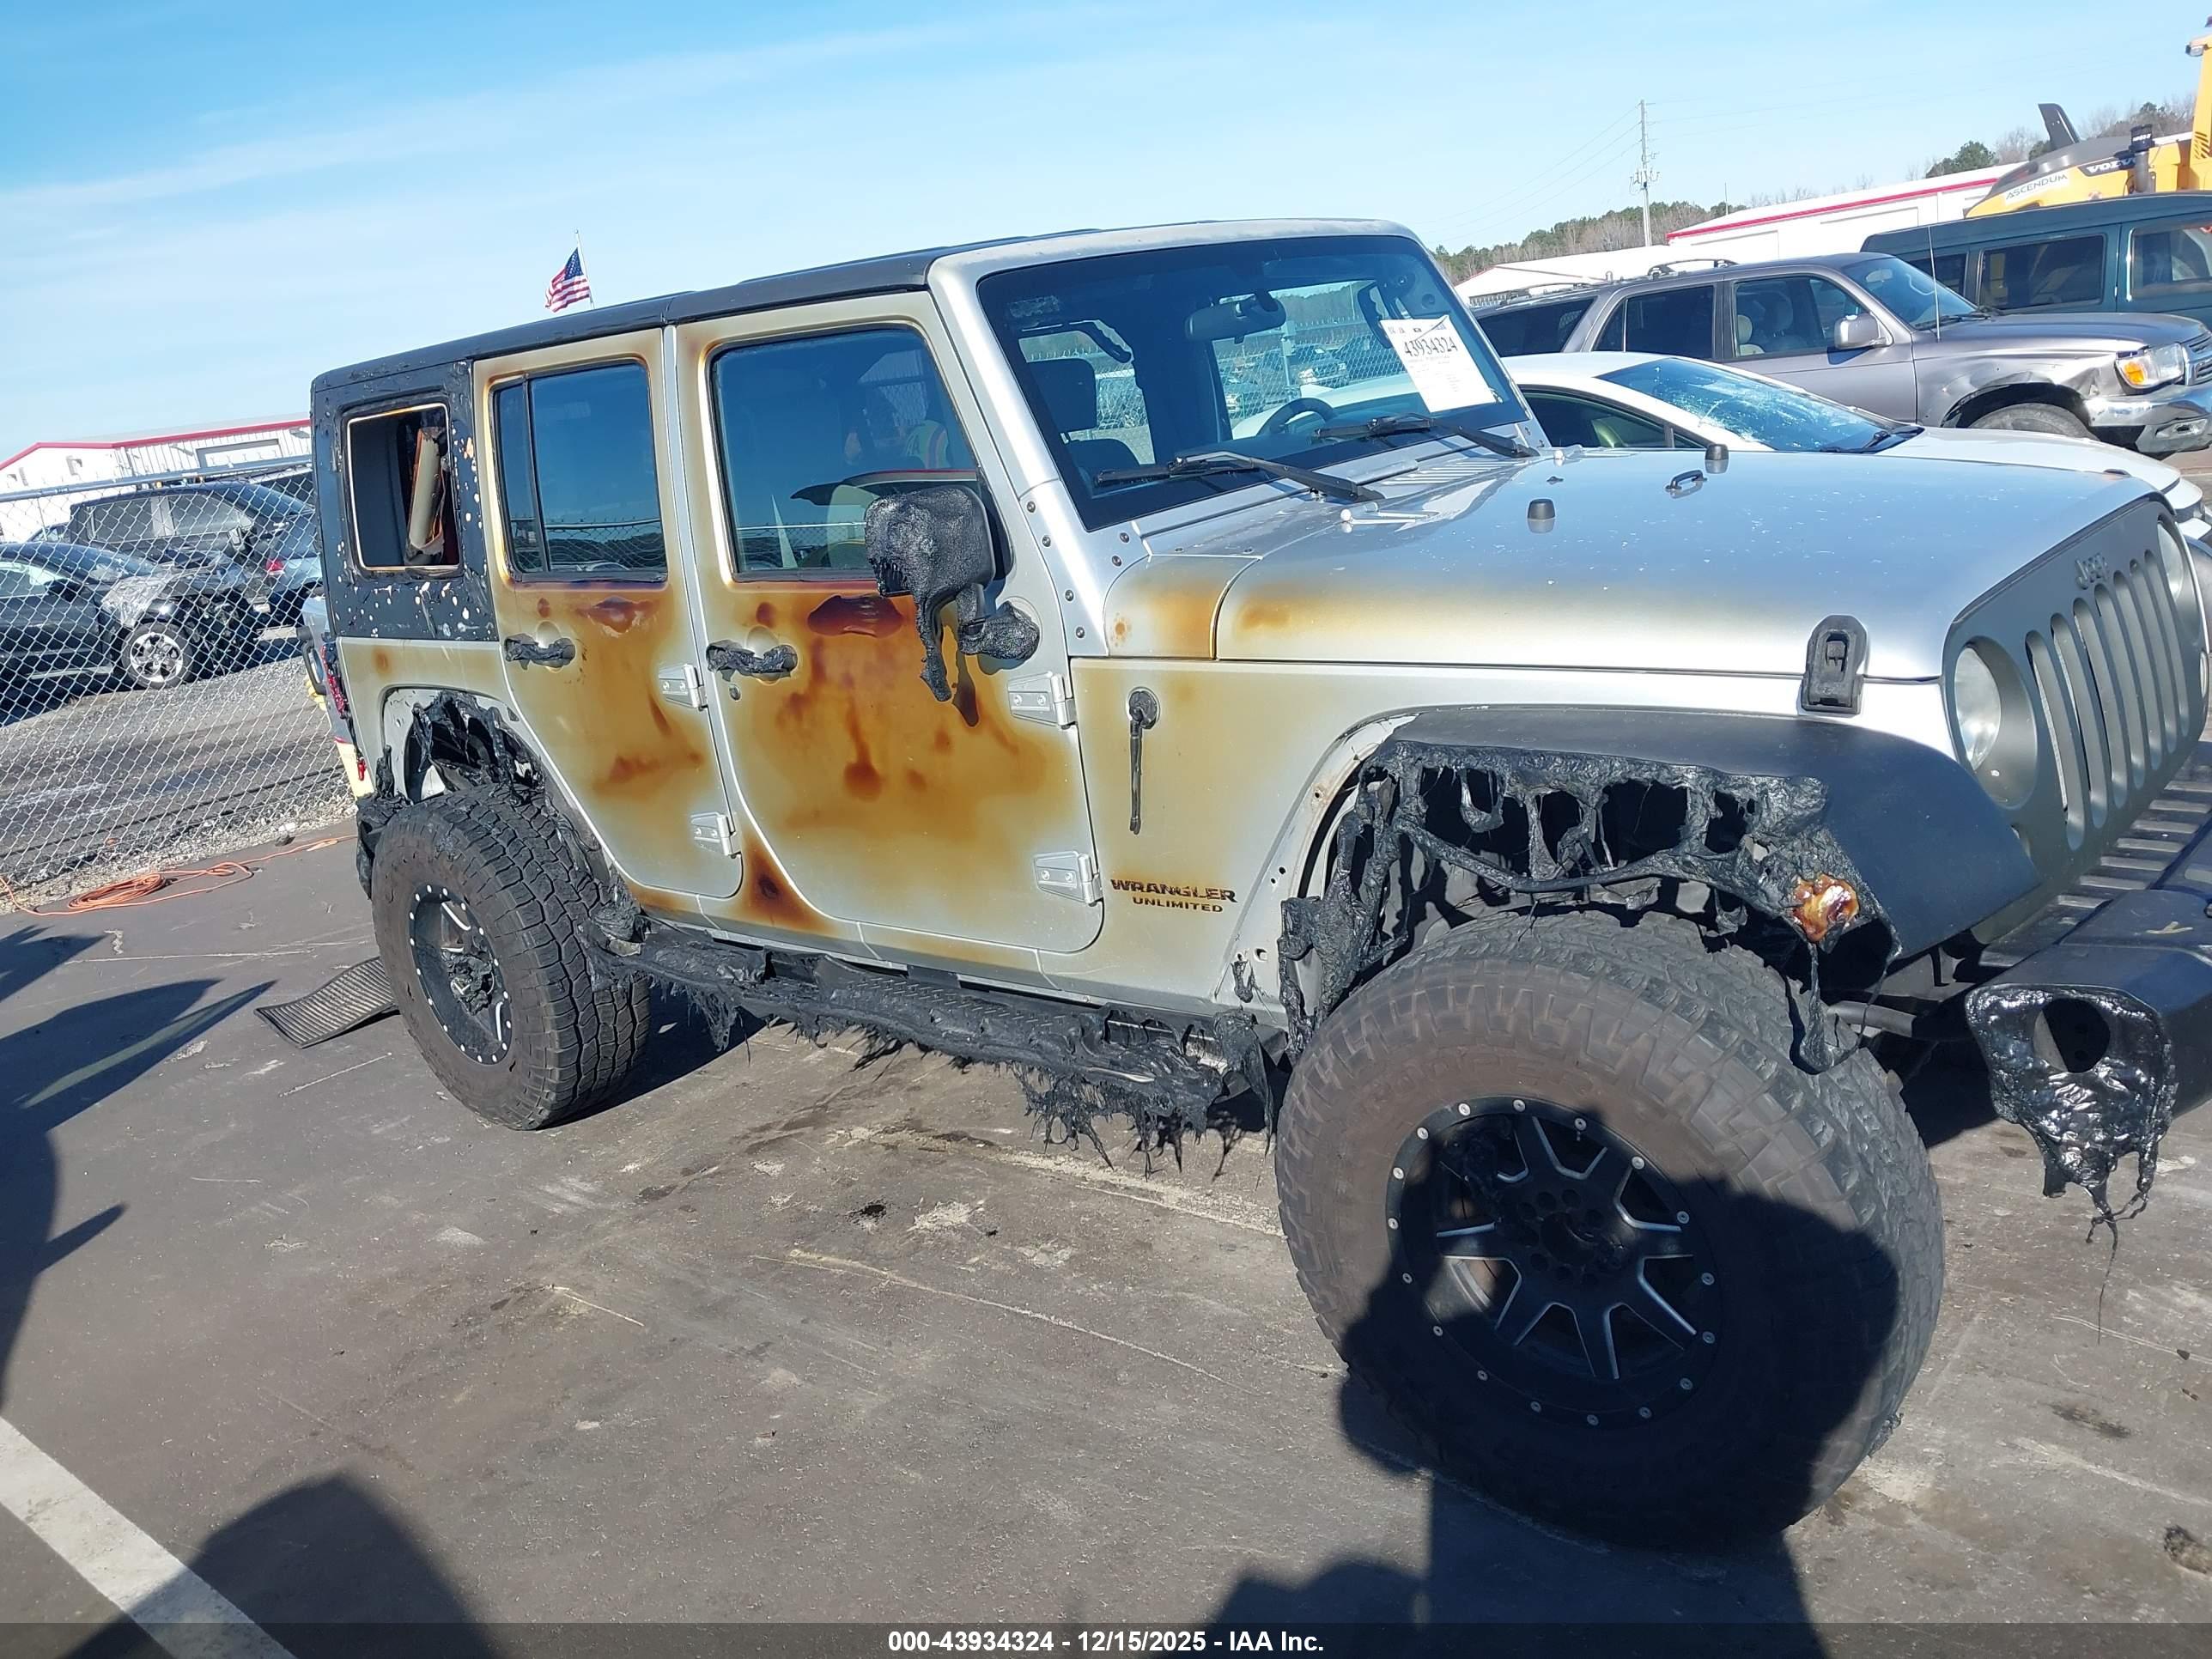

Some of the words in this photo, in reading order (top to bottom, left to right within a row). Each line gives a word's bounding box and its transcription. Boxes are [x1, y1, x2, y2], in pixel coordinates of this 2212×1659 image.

[2006, 173, 2068, 200] ASCENDUM
[1405, 336, 1458, 356] 43934324
[1110, 878, 1238, 902] WRANGLER
[1133, 896, 1224, 912] UNLIMITED
